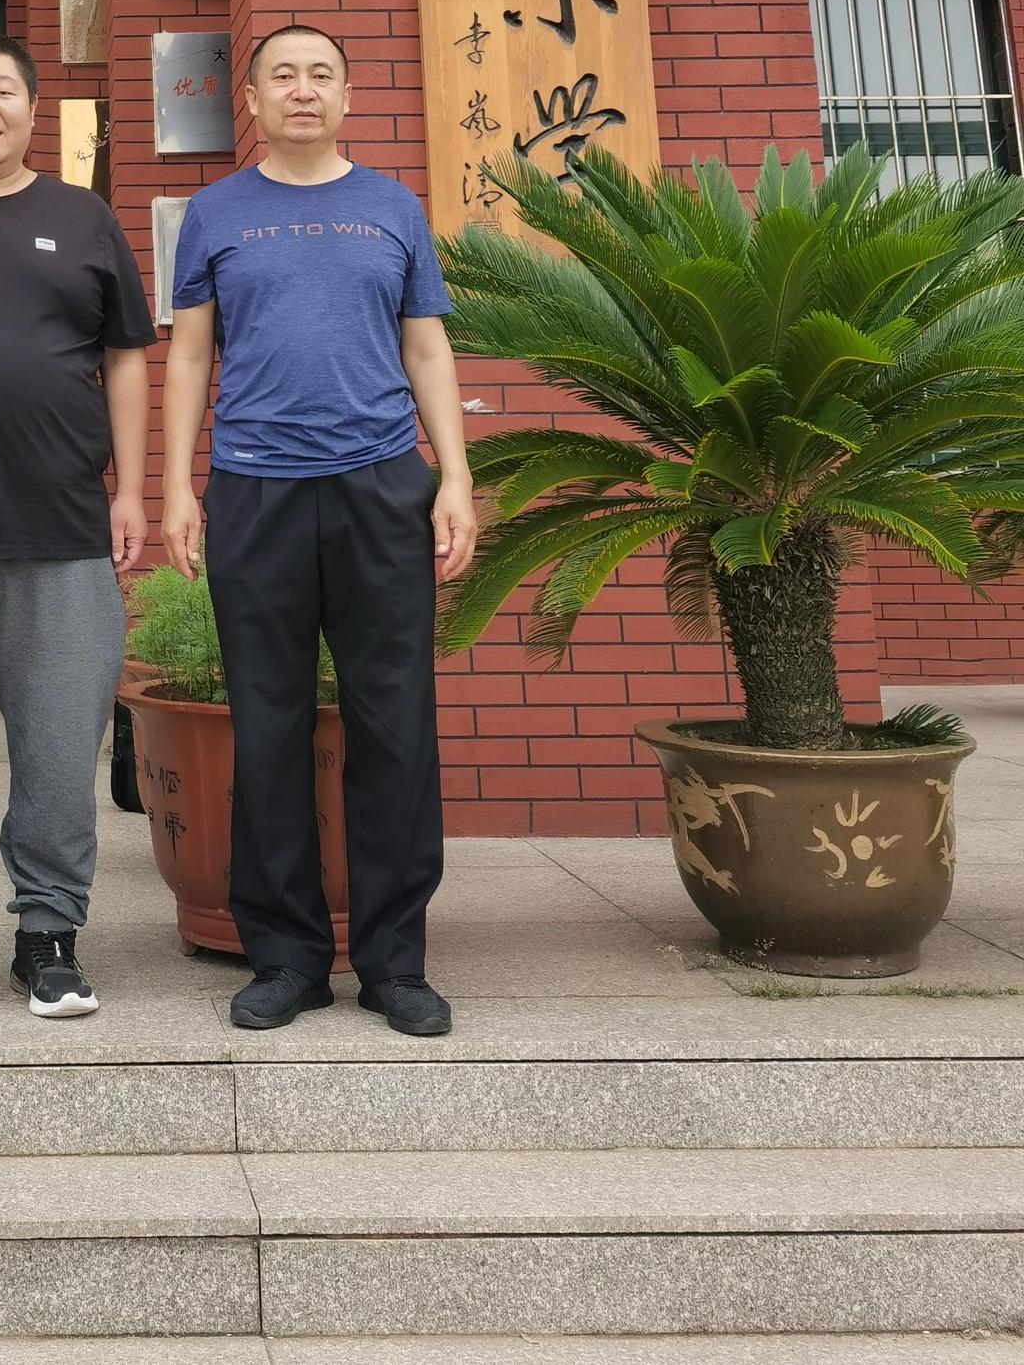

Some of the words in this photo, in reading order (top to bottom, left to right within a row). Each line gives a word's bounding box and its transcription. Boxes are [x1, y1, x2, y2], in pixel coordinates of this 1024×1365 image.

[214, 49, 227, 62] 大
[172, 74, 218, 97] 优质
[242, 226, 281, 242] FIT
[288, 223, 324, 236] TO
[332, 222, 381, 240] WIN
